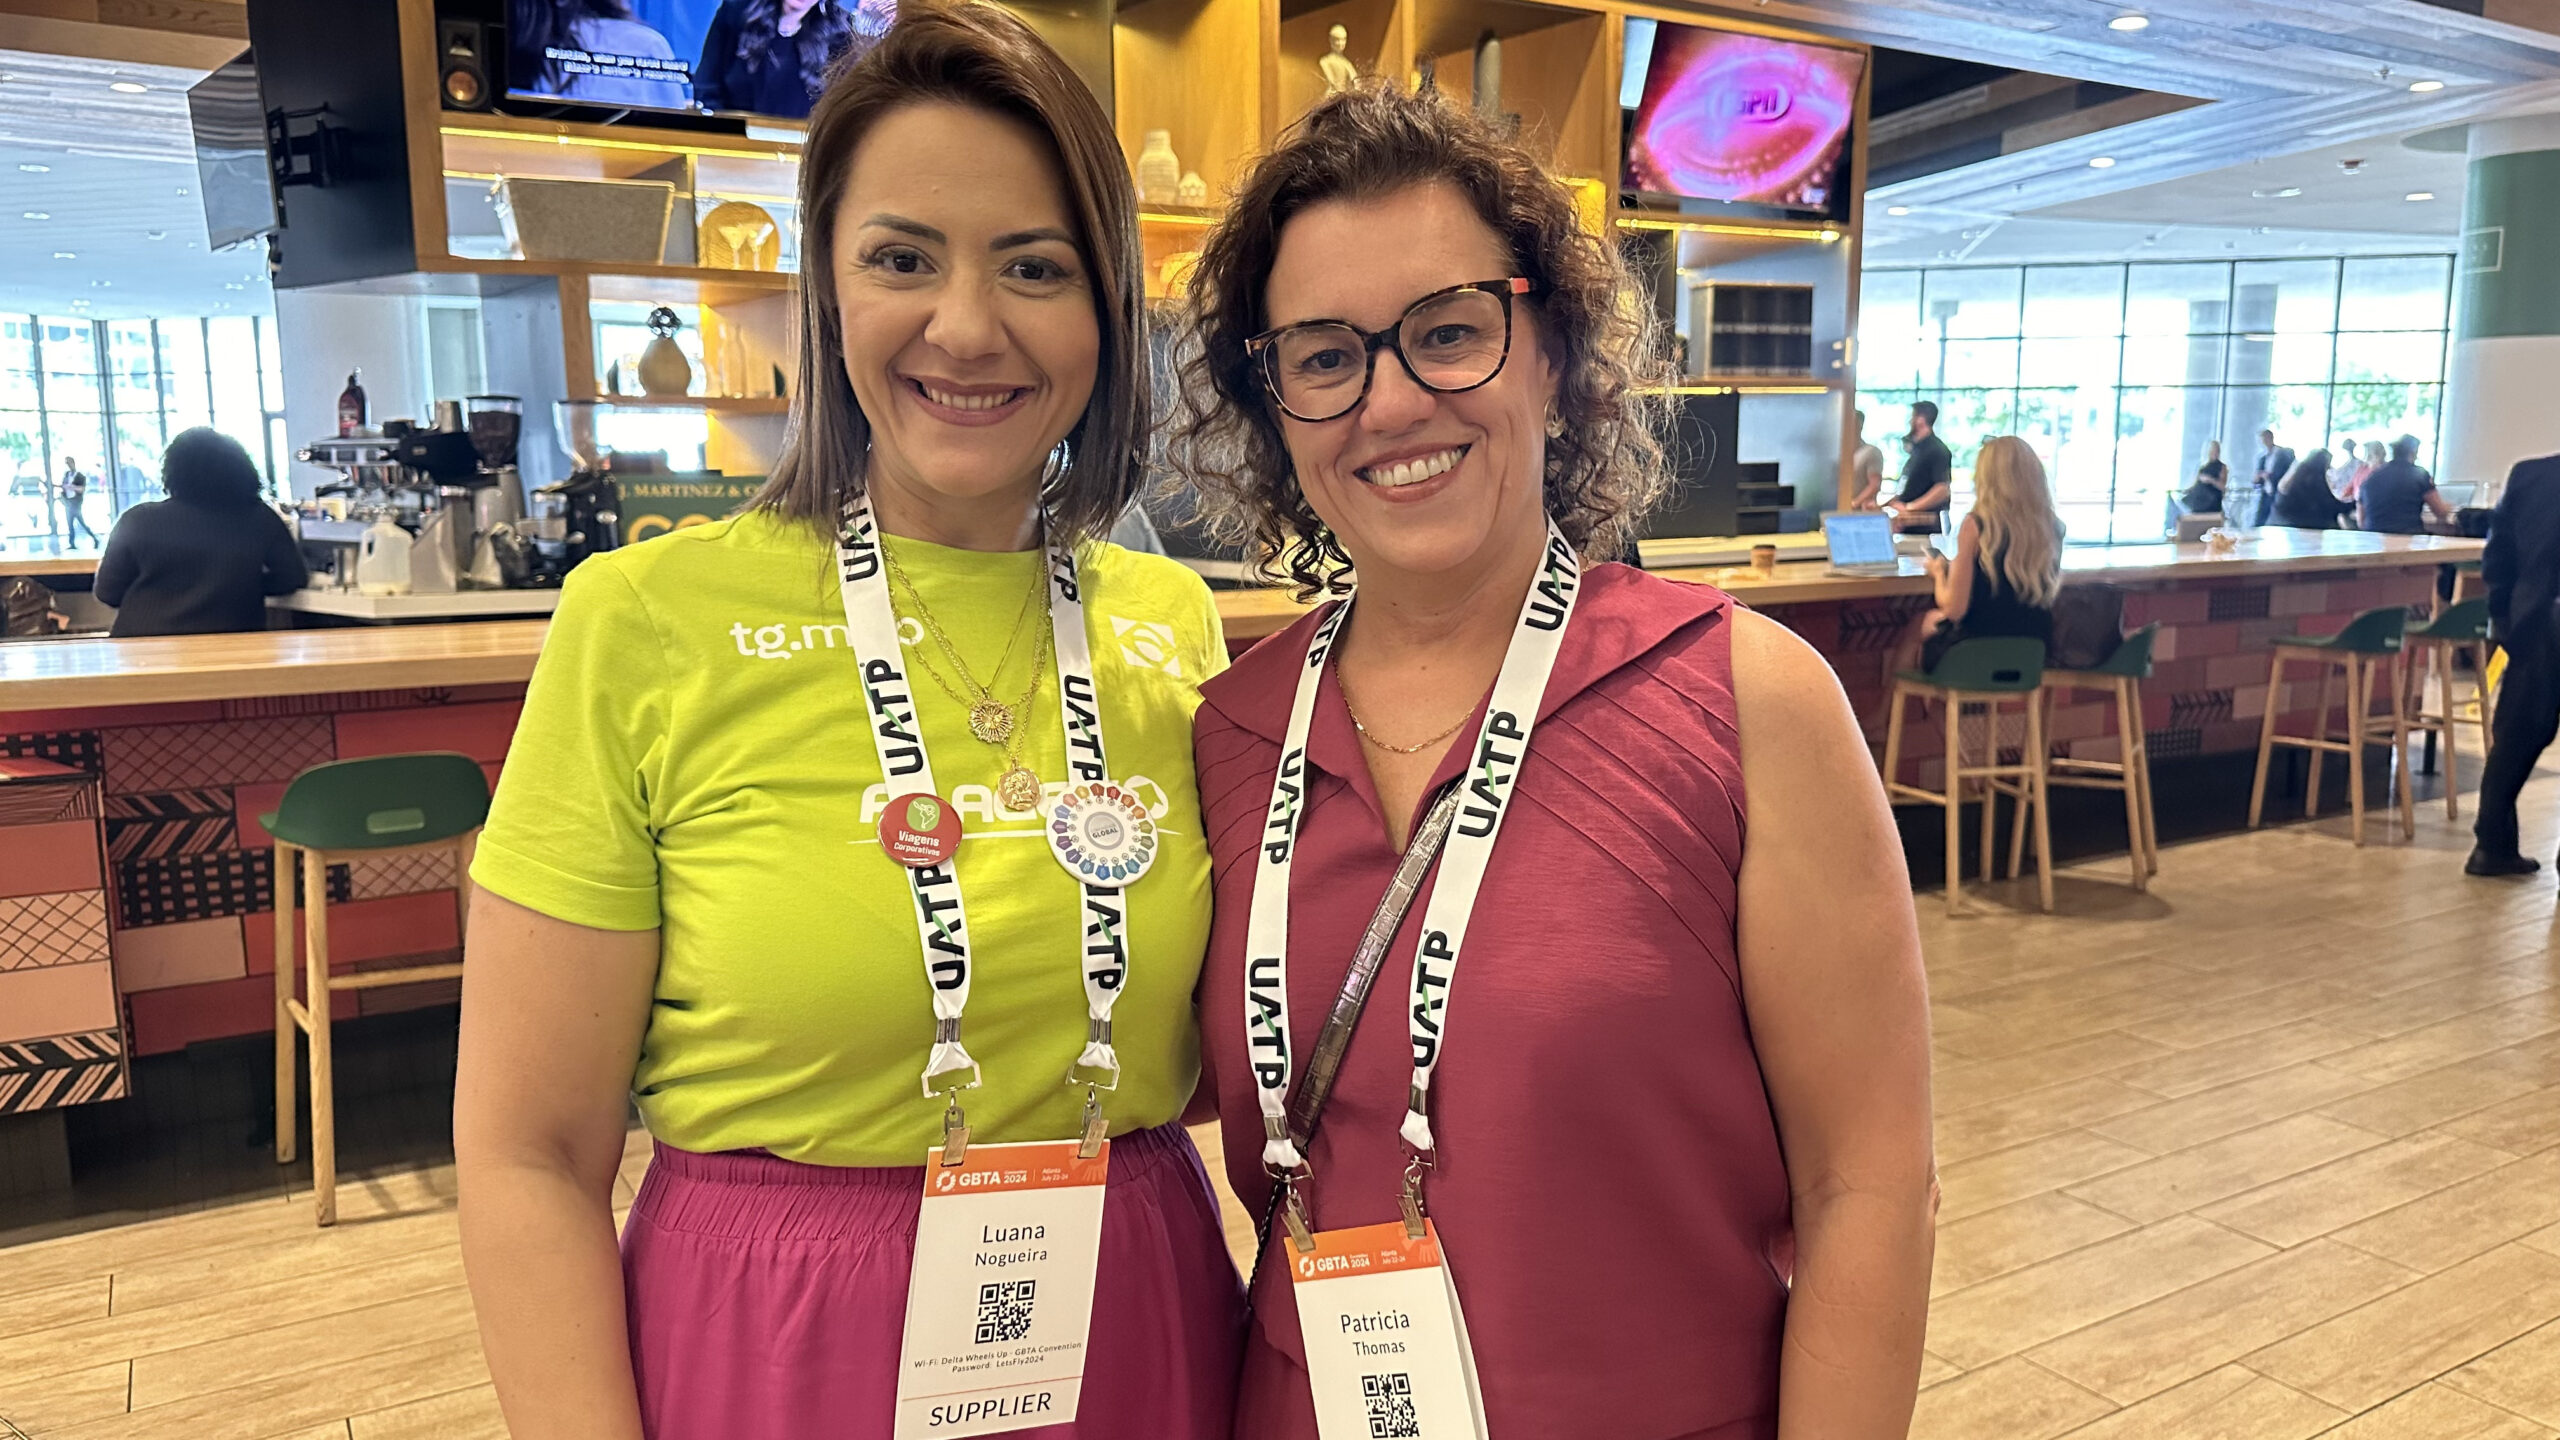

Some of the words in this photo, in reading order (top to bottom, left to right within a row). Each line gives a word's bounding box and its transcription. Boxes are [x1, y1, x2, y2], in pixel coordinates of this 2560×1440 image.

[634, 483, 726, 498] MARTINEZ
[728, 484, 740, 498] &
[1524, 535, 1578, 632] UATP
[865, 658, 924, 777] UATP
[1457, 711, 1525, 838] UATP
[1264, 746, 1303, 865] UATP
[898, 830, 940, 847] Viagens
[1092, 828, 1119, 839] GLOBAL
[893, 842, 941, 857] Corporativas
[1411, 930, 1454, 1068] UATP
[1249, 957, 1287, 1090] UATP
[959, 1171, 1002, 1187] GBTA
[1003, 1174, 1028, 1184] 2024
[982, 1224, 1046, 1244] Luana
[974, 1248, 1048, 1268] Nogueira
[1316, 1255, 1350, 1272] GBTA
[1350, 1258, 1371, 1269] 2024
[1341, 1309, 1411, 1334] Patricia
[941, 1355, 964, 1365] Delta
[965, 1352, 995, 1362] Wheels
[996, 1351, 1008, 1360] Up
[1014, 1347, 1037, 1356] GBTA
[1038, 1342, 1082, 1353] Convention
[1352, 1341, 1406, 1357] Thomas
[928, 1391, 1053, 1428] SUPPLIER
